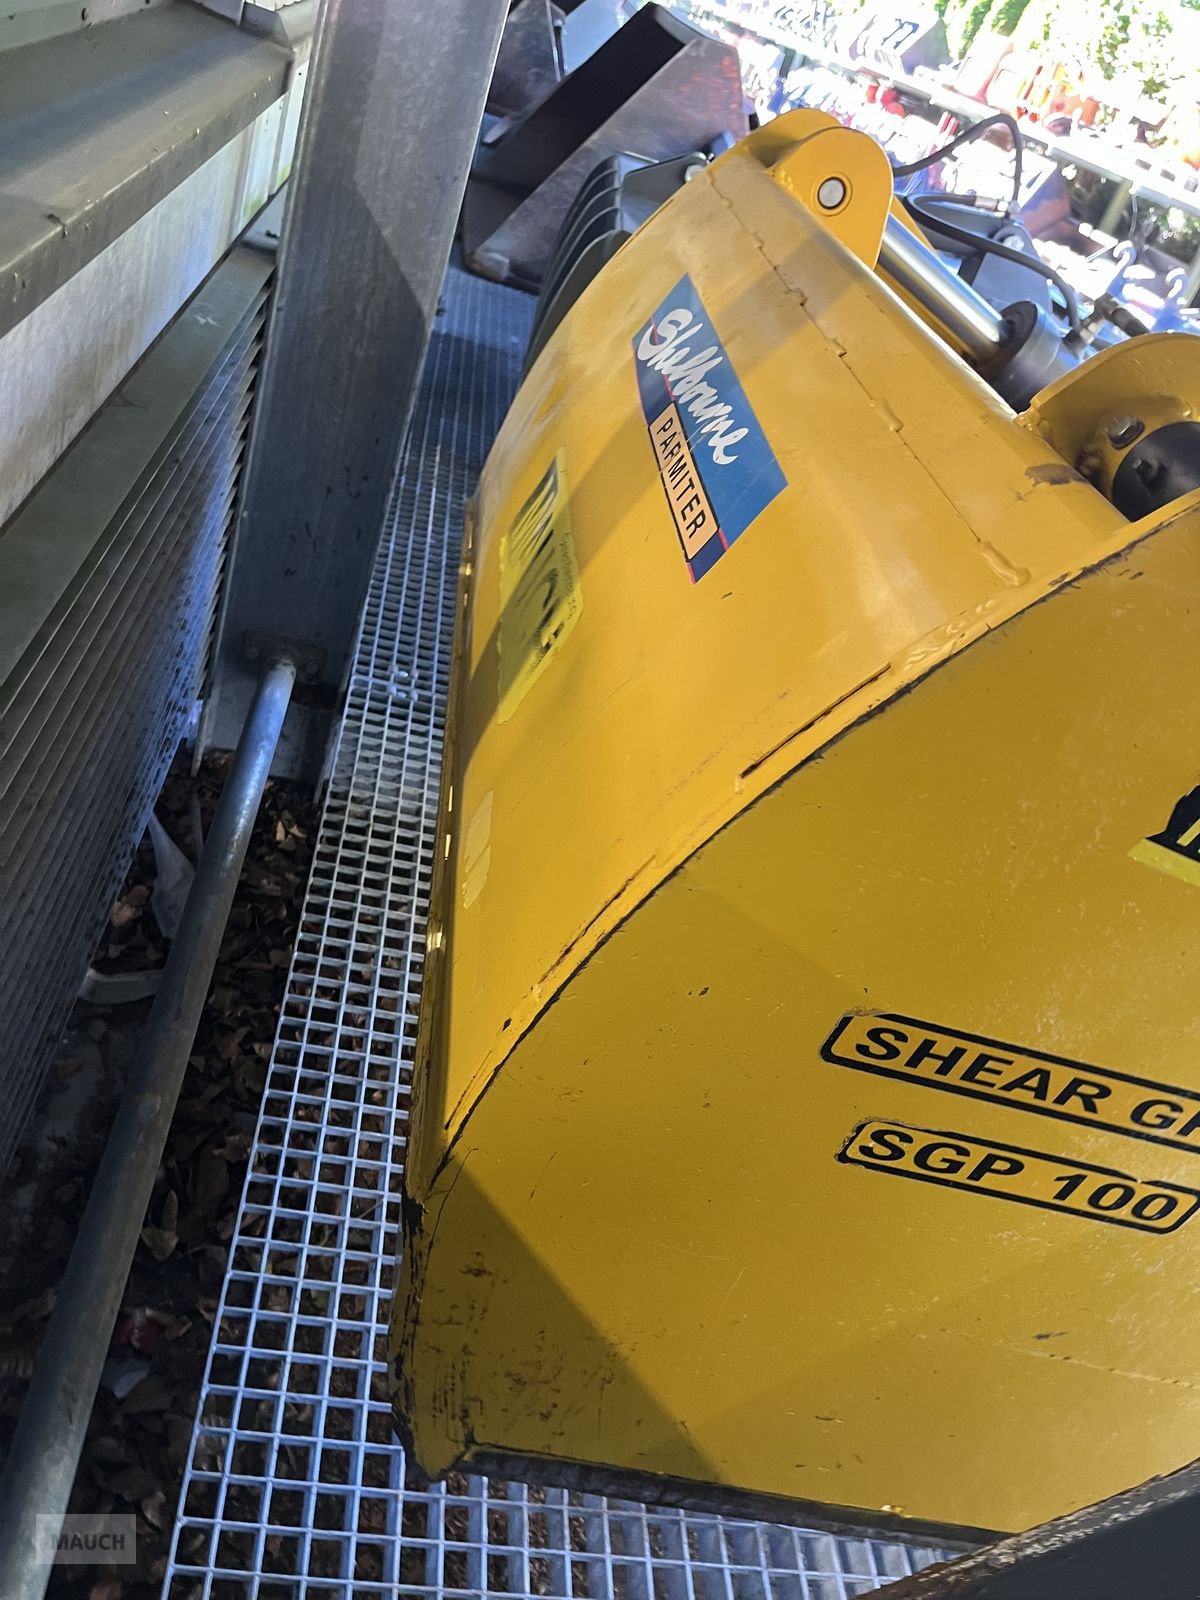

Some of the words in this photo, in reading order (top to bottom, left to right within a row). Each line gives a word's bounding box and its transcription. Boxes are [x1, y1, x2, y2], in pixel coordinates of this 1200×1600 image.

[656, 417, 706, 540] PARMITER
[855, 1026, 1112, 1115] SHEAR
[858, 1128, 1025, 1182] SGP
[1052, 1173, 1180, 1222] 100
